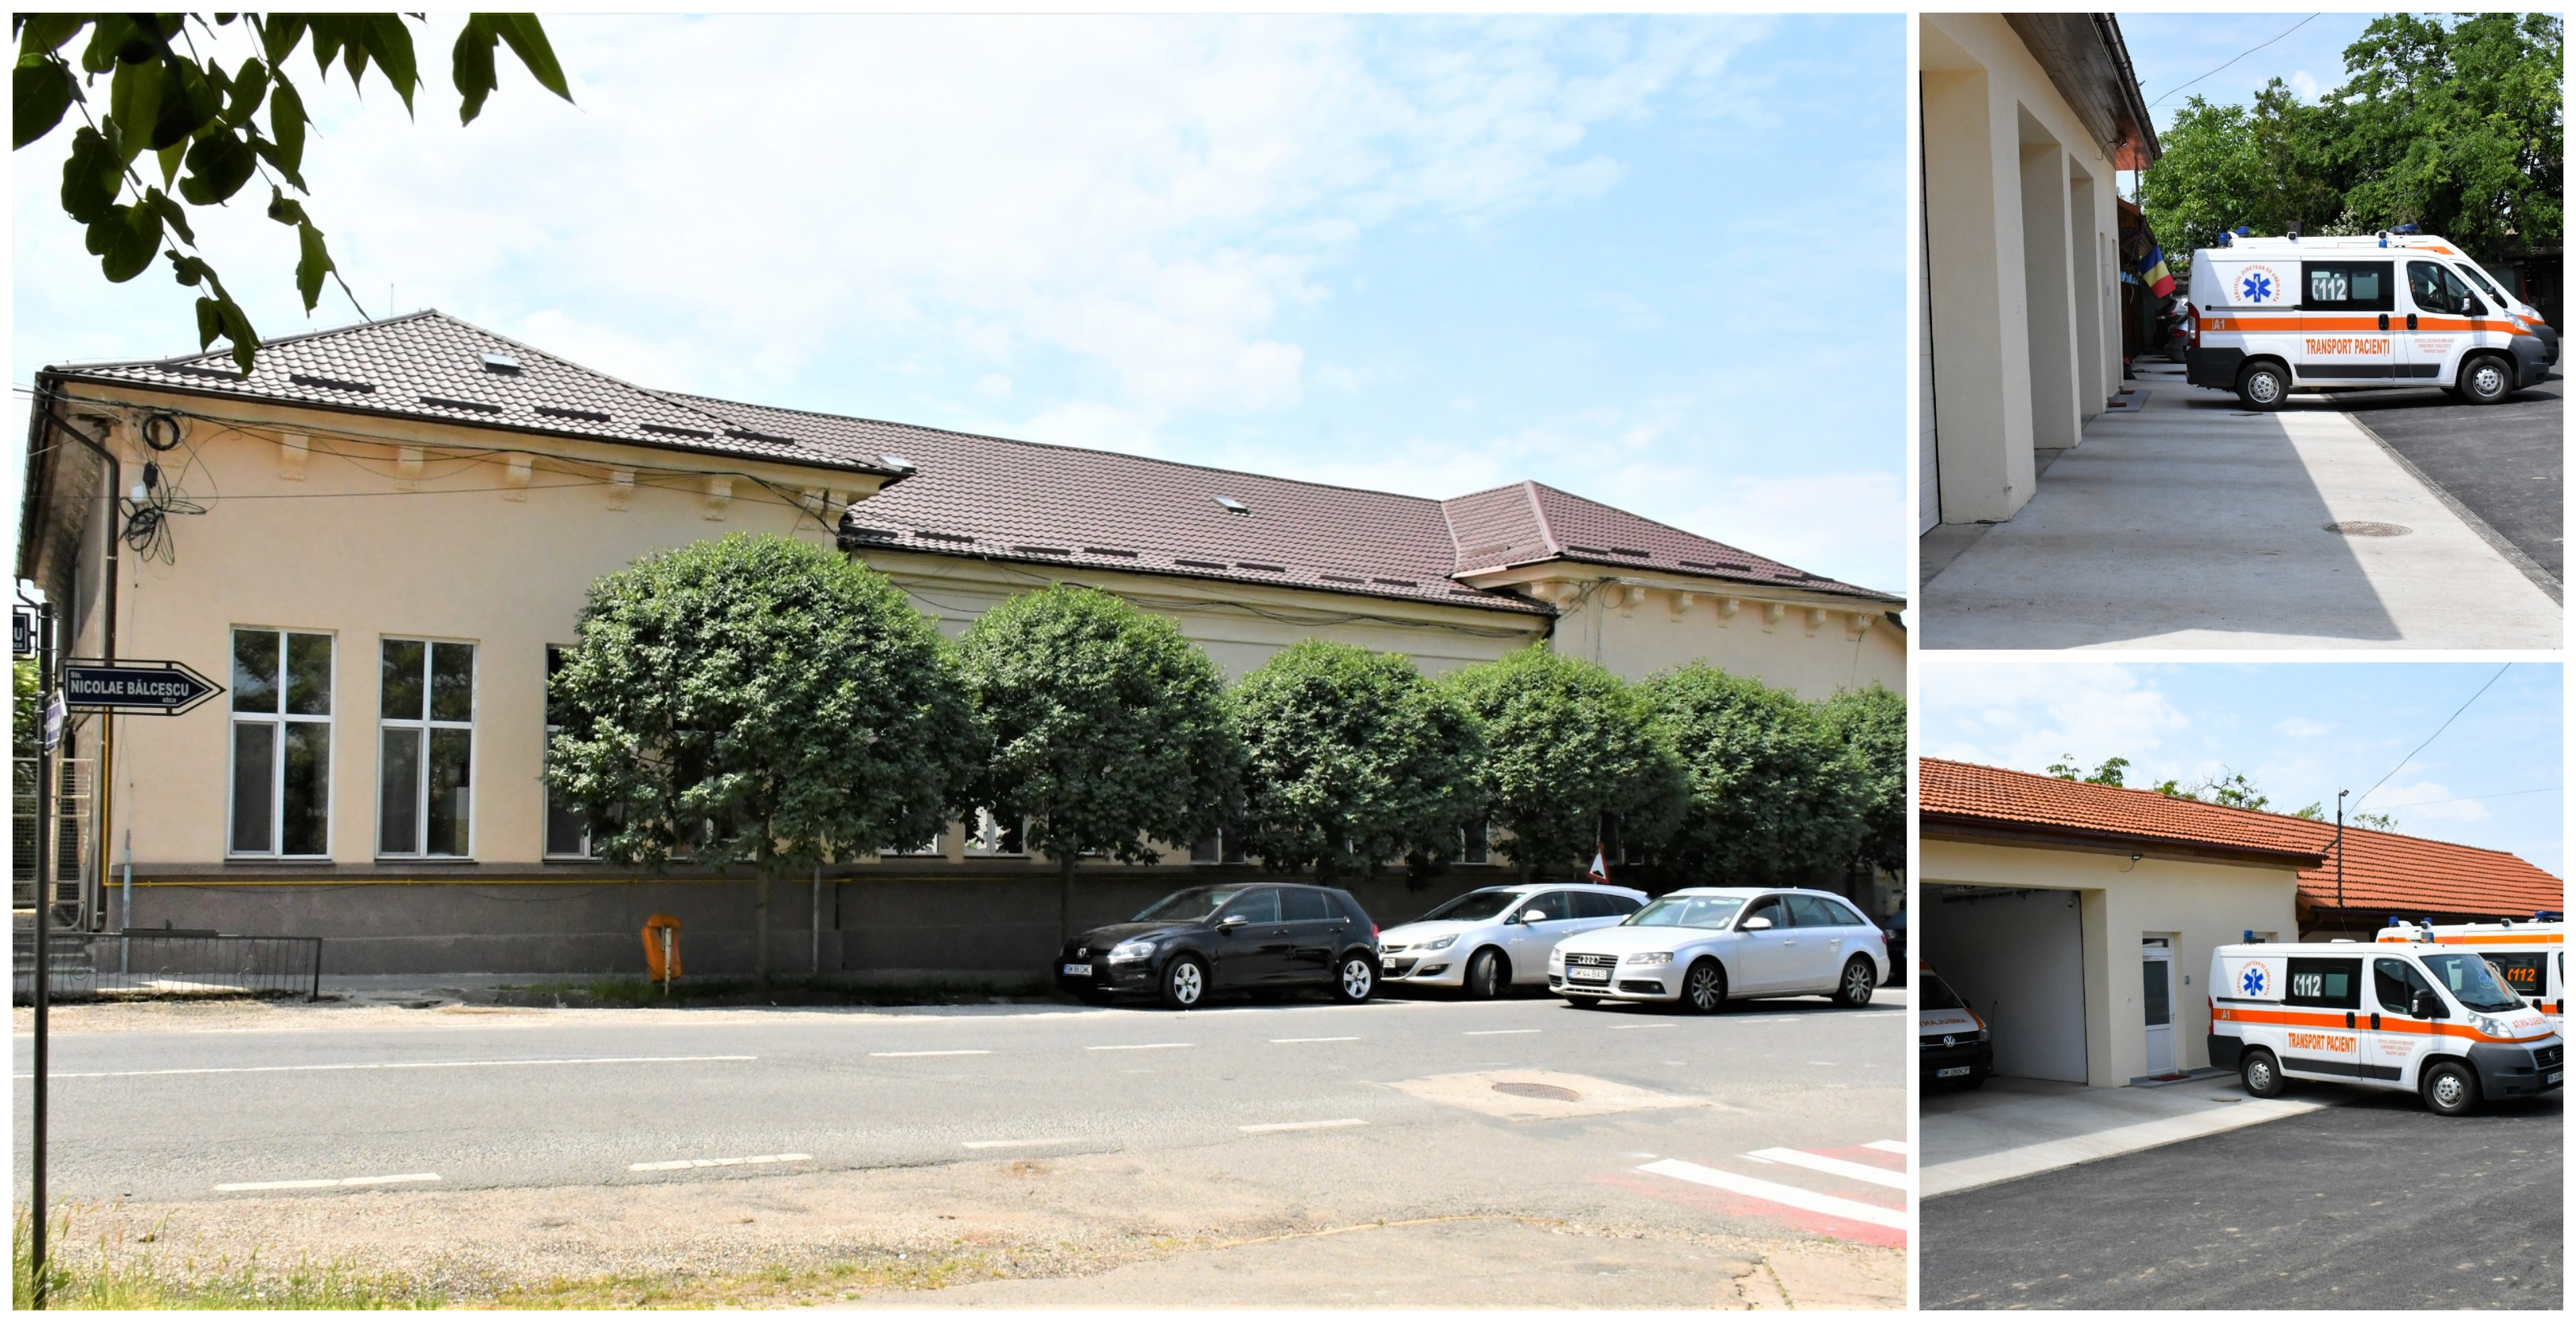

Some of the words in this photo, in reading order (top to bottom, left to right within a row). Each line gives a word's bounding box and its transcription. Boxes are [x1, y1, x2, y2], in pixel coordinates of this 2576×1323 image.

[2213, 319, 2225, 330] A1
[2305, 339, 2352, 354] TRANSPORT
[70, 680, 124, 695] NICOLAE
[127, 679, 189, 697] BĂLCESCU
[2222, 1010, 2230, 1019] A1
[2288, 1033, 2325, 1050] TRANSPORT
